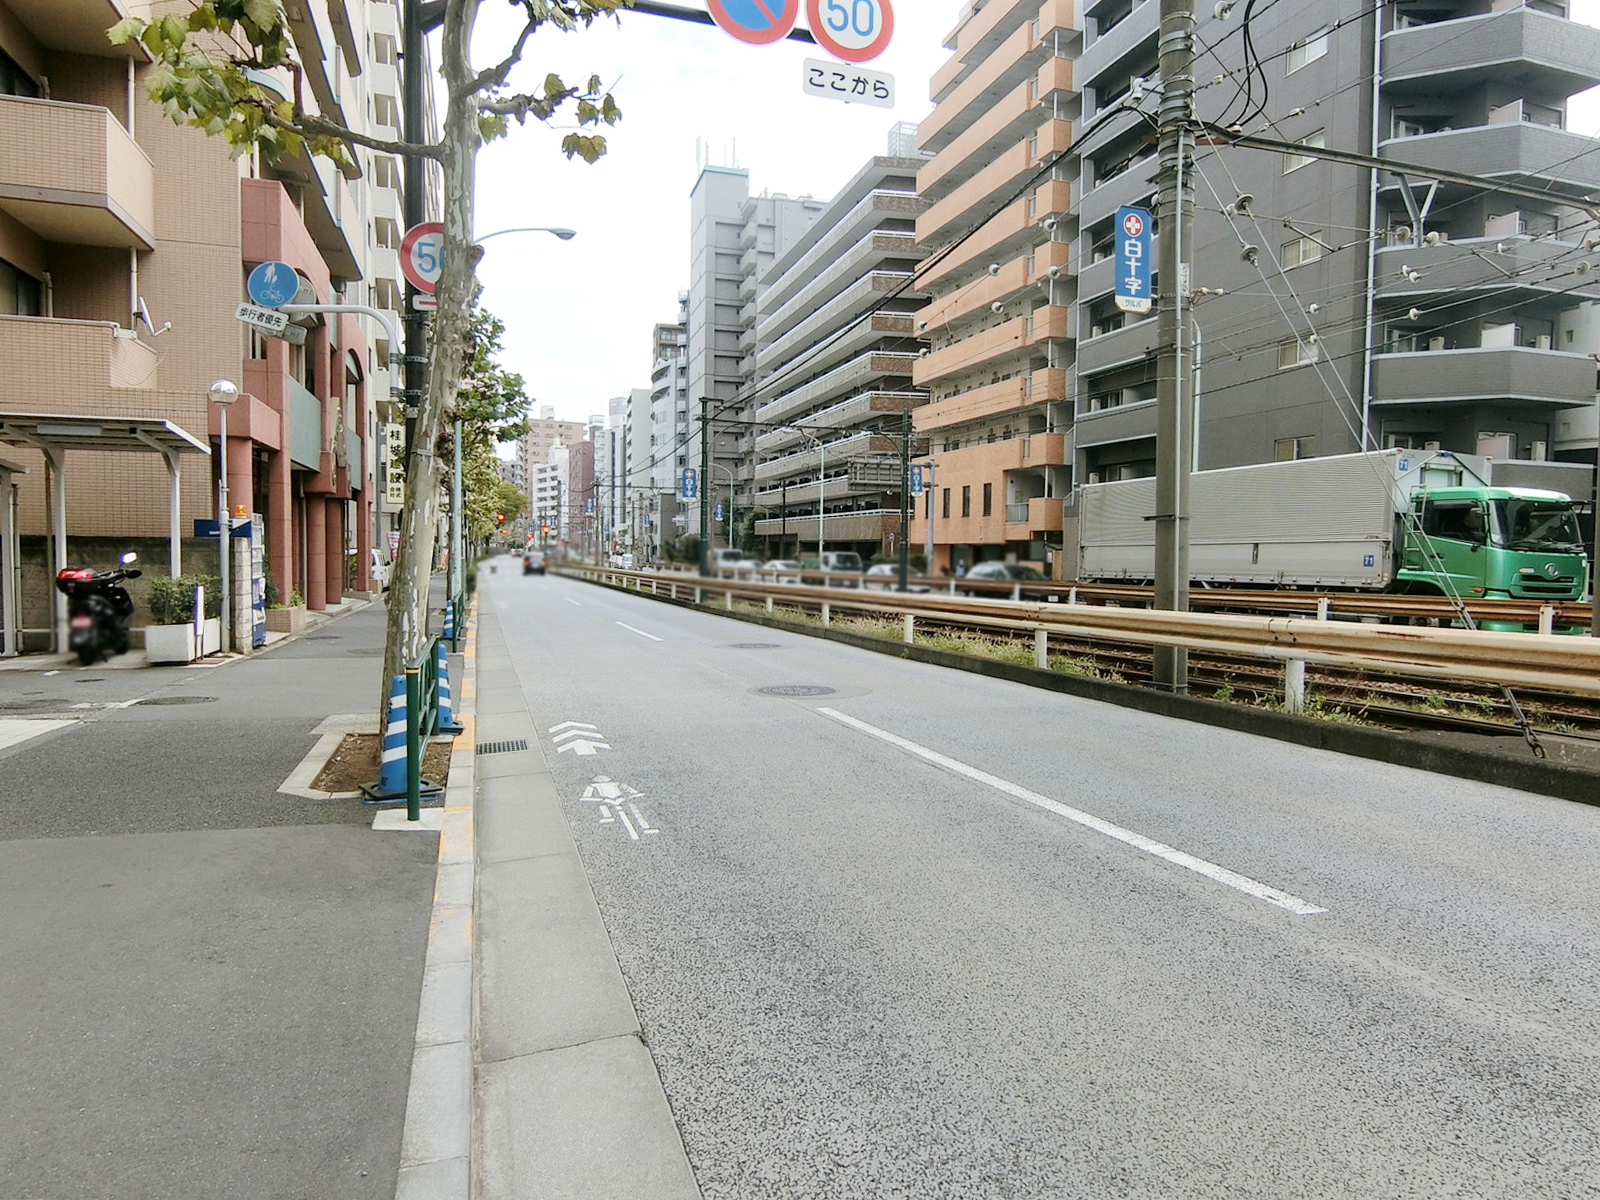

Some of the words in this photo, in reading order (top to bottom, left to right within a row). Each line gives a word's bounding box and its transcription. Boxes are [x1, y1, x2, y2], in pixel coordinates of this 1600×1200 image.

[827, 0, 874, 36] 50
[809, 68, 889, 99] ここから
[1124, 238, 1142, 296] 白十字
[239, 306, 283, 327] 歩行者優先
[1399, 460, 1408, 470] 71
[1364, 557, 1373, 565] 71
